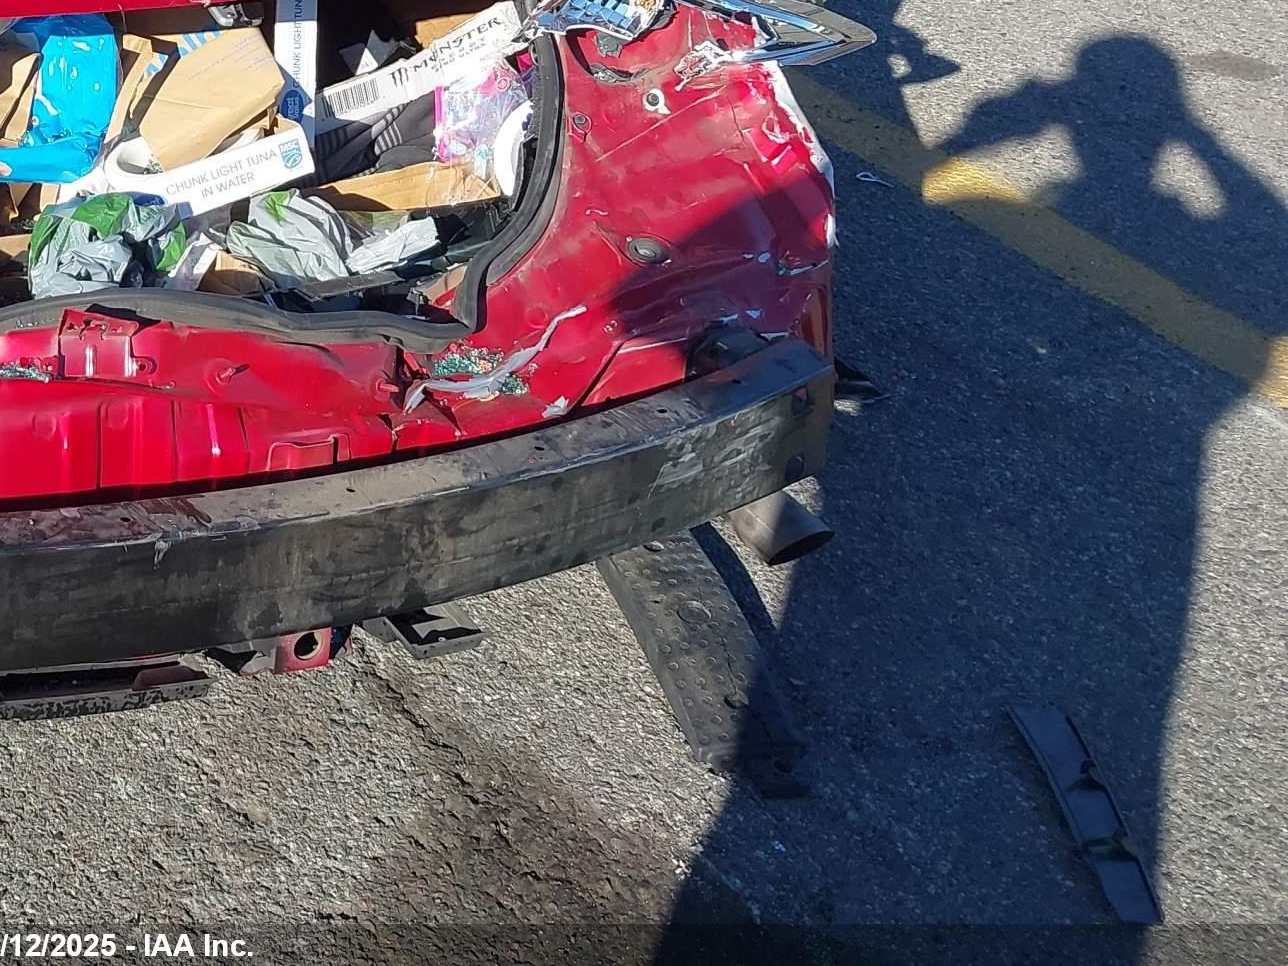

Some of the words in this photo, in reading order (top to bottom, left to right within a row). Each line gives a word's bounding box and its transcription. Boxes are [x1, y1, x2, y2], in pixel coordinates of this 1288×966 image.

[293, 20, 302, 51] LIGHT
[413, 16, 503, 73] MONSTER
[292, 51, 302, 89] CHUNK
[280, 139, 302, 154] MSC
[166, 172, 209, 196] CHUNK
[211, 161, 245, 184] LIGHT
[246, 147, 278, 169] TUNA
[200, 186, 214, 199] IN
[216, 171, 256, 194] WATER
